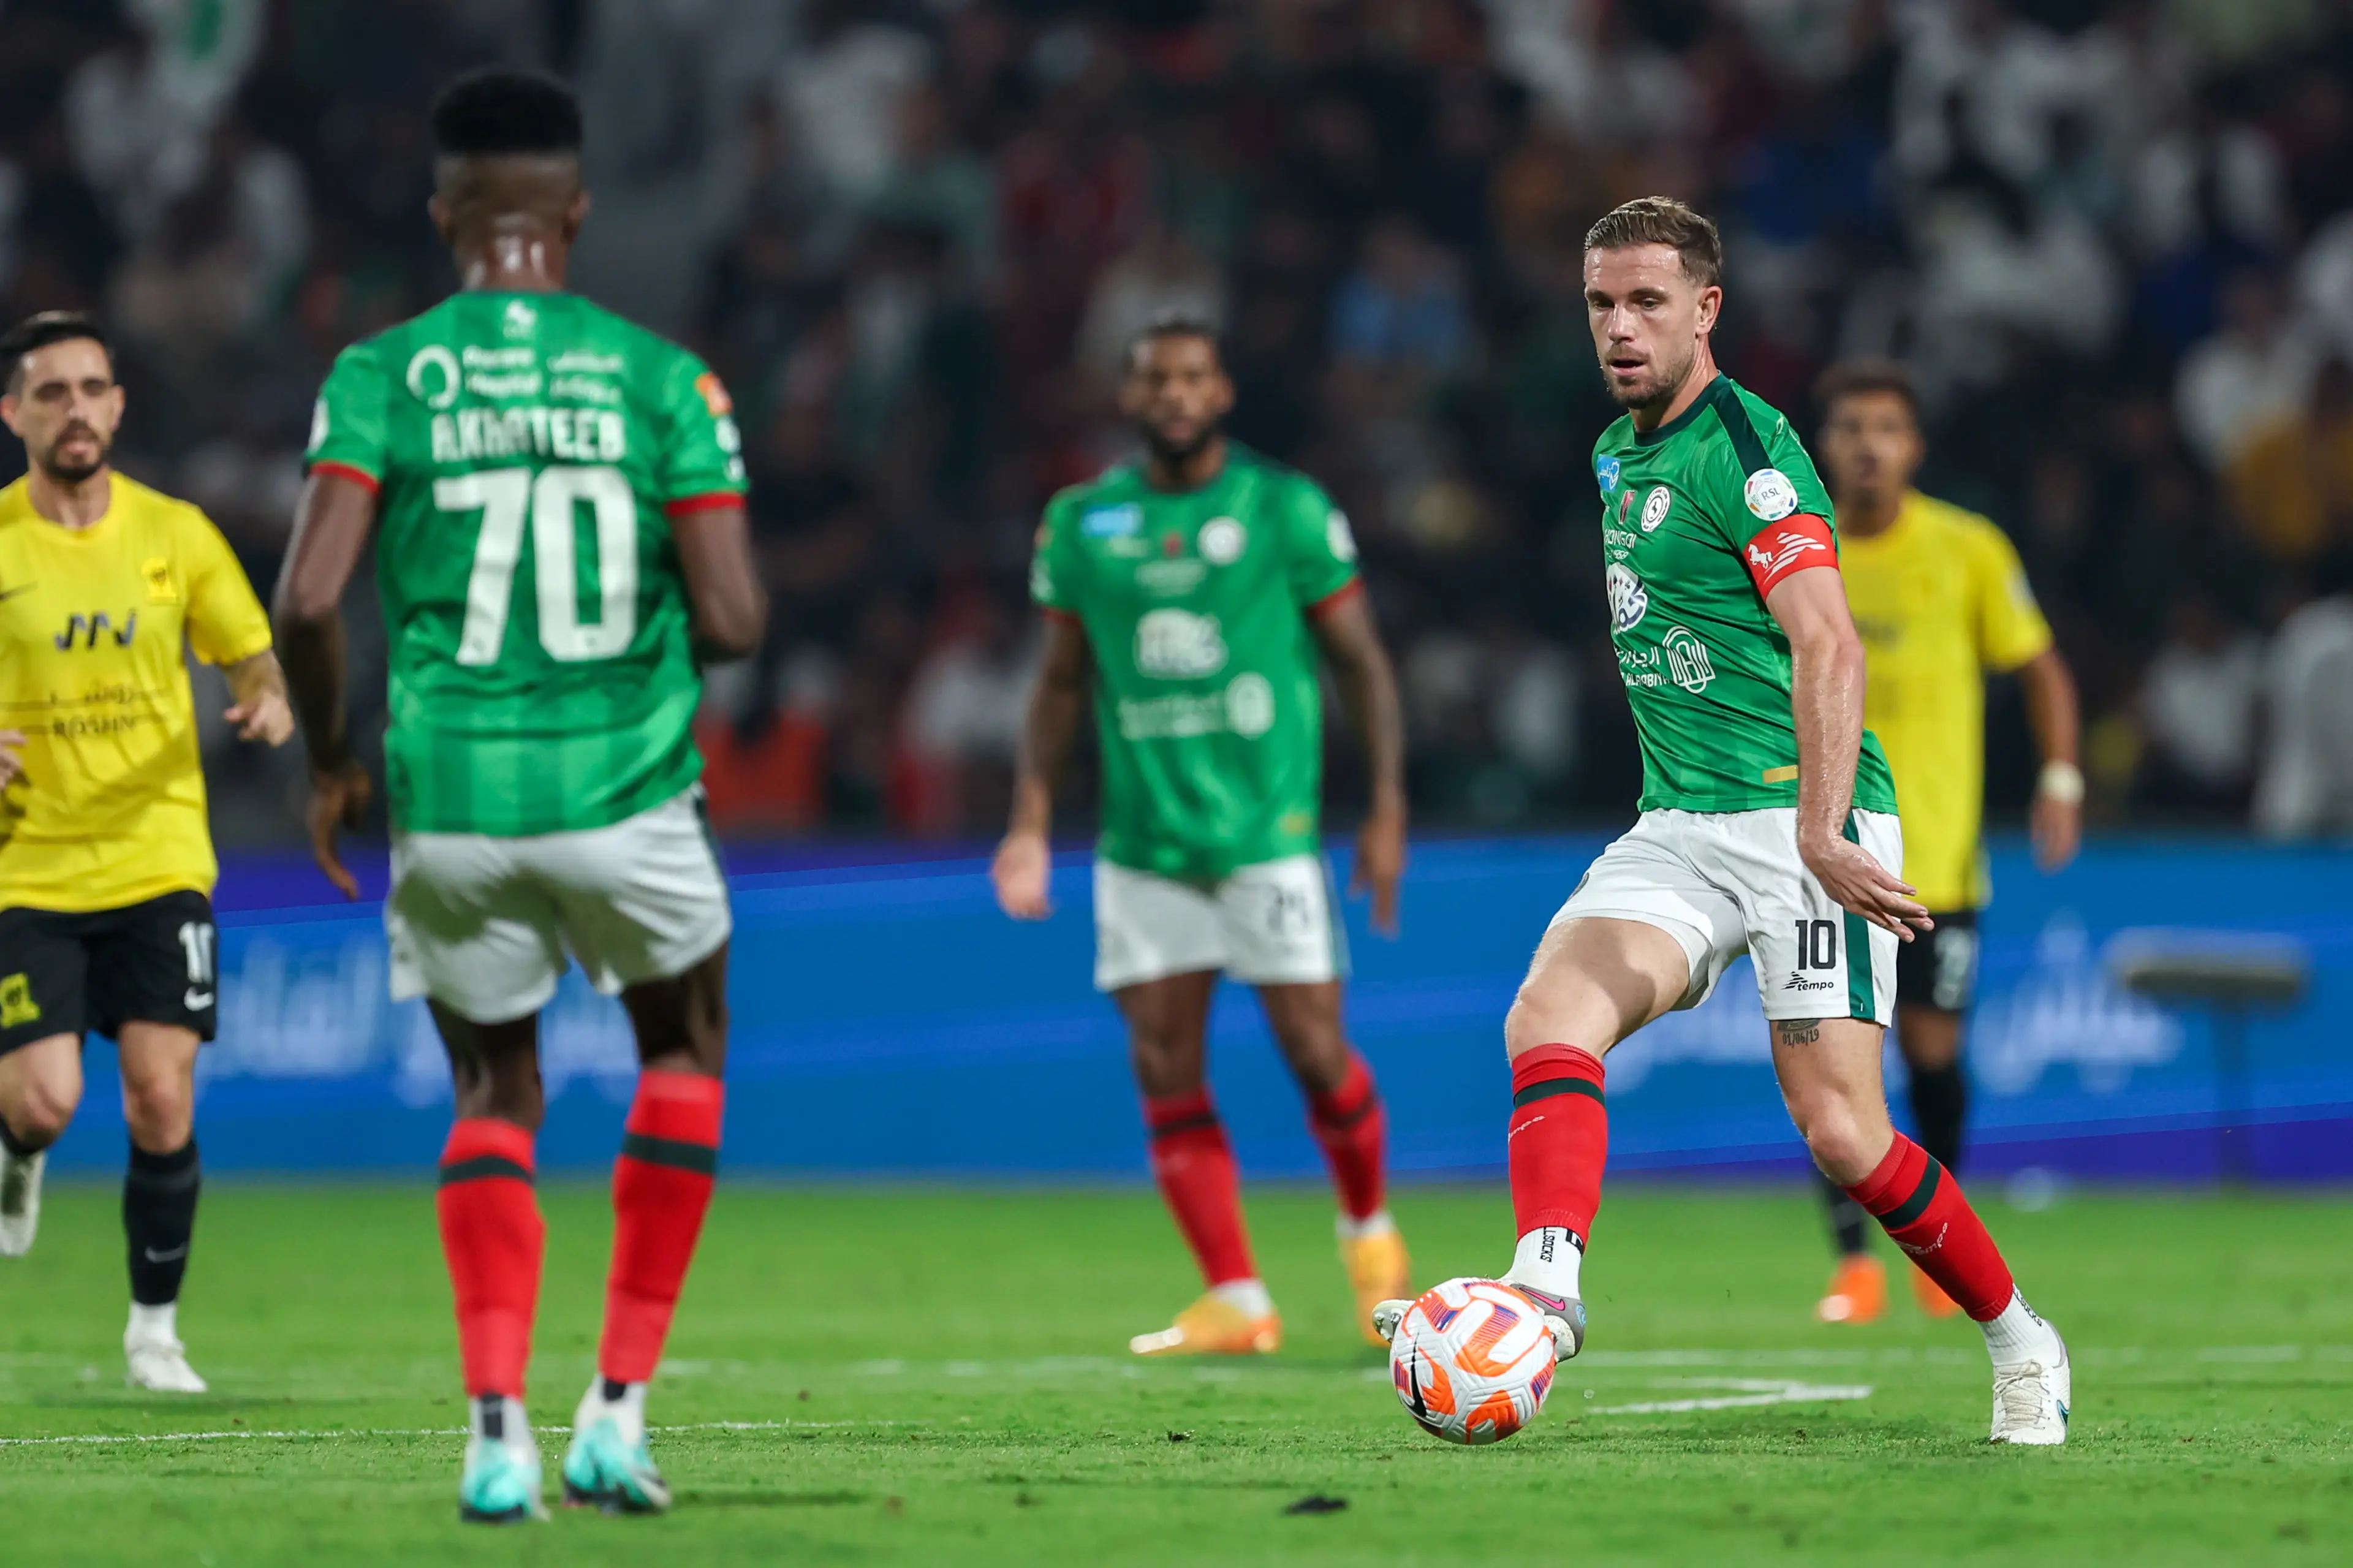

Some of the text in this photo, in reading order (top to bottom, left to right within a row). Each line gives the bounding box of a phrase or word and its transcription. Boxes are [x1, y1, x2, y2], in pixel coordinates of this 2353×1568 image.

[1761, 488, 1781, 501] RSL
[433, 466, 636, 665] 70
[1795, 920, 1836, 970] 10
[1797, 981, 1834, 991] tempo
[1783, 1028, 1819, 1048] 01/06/19
